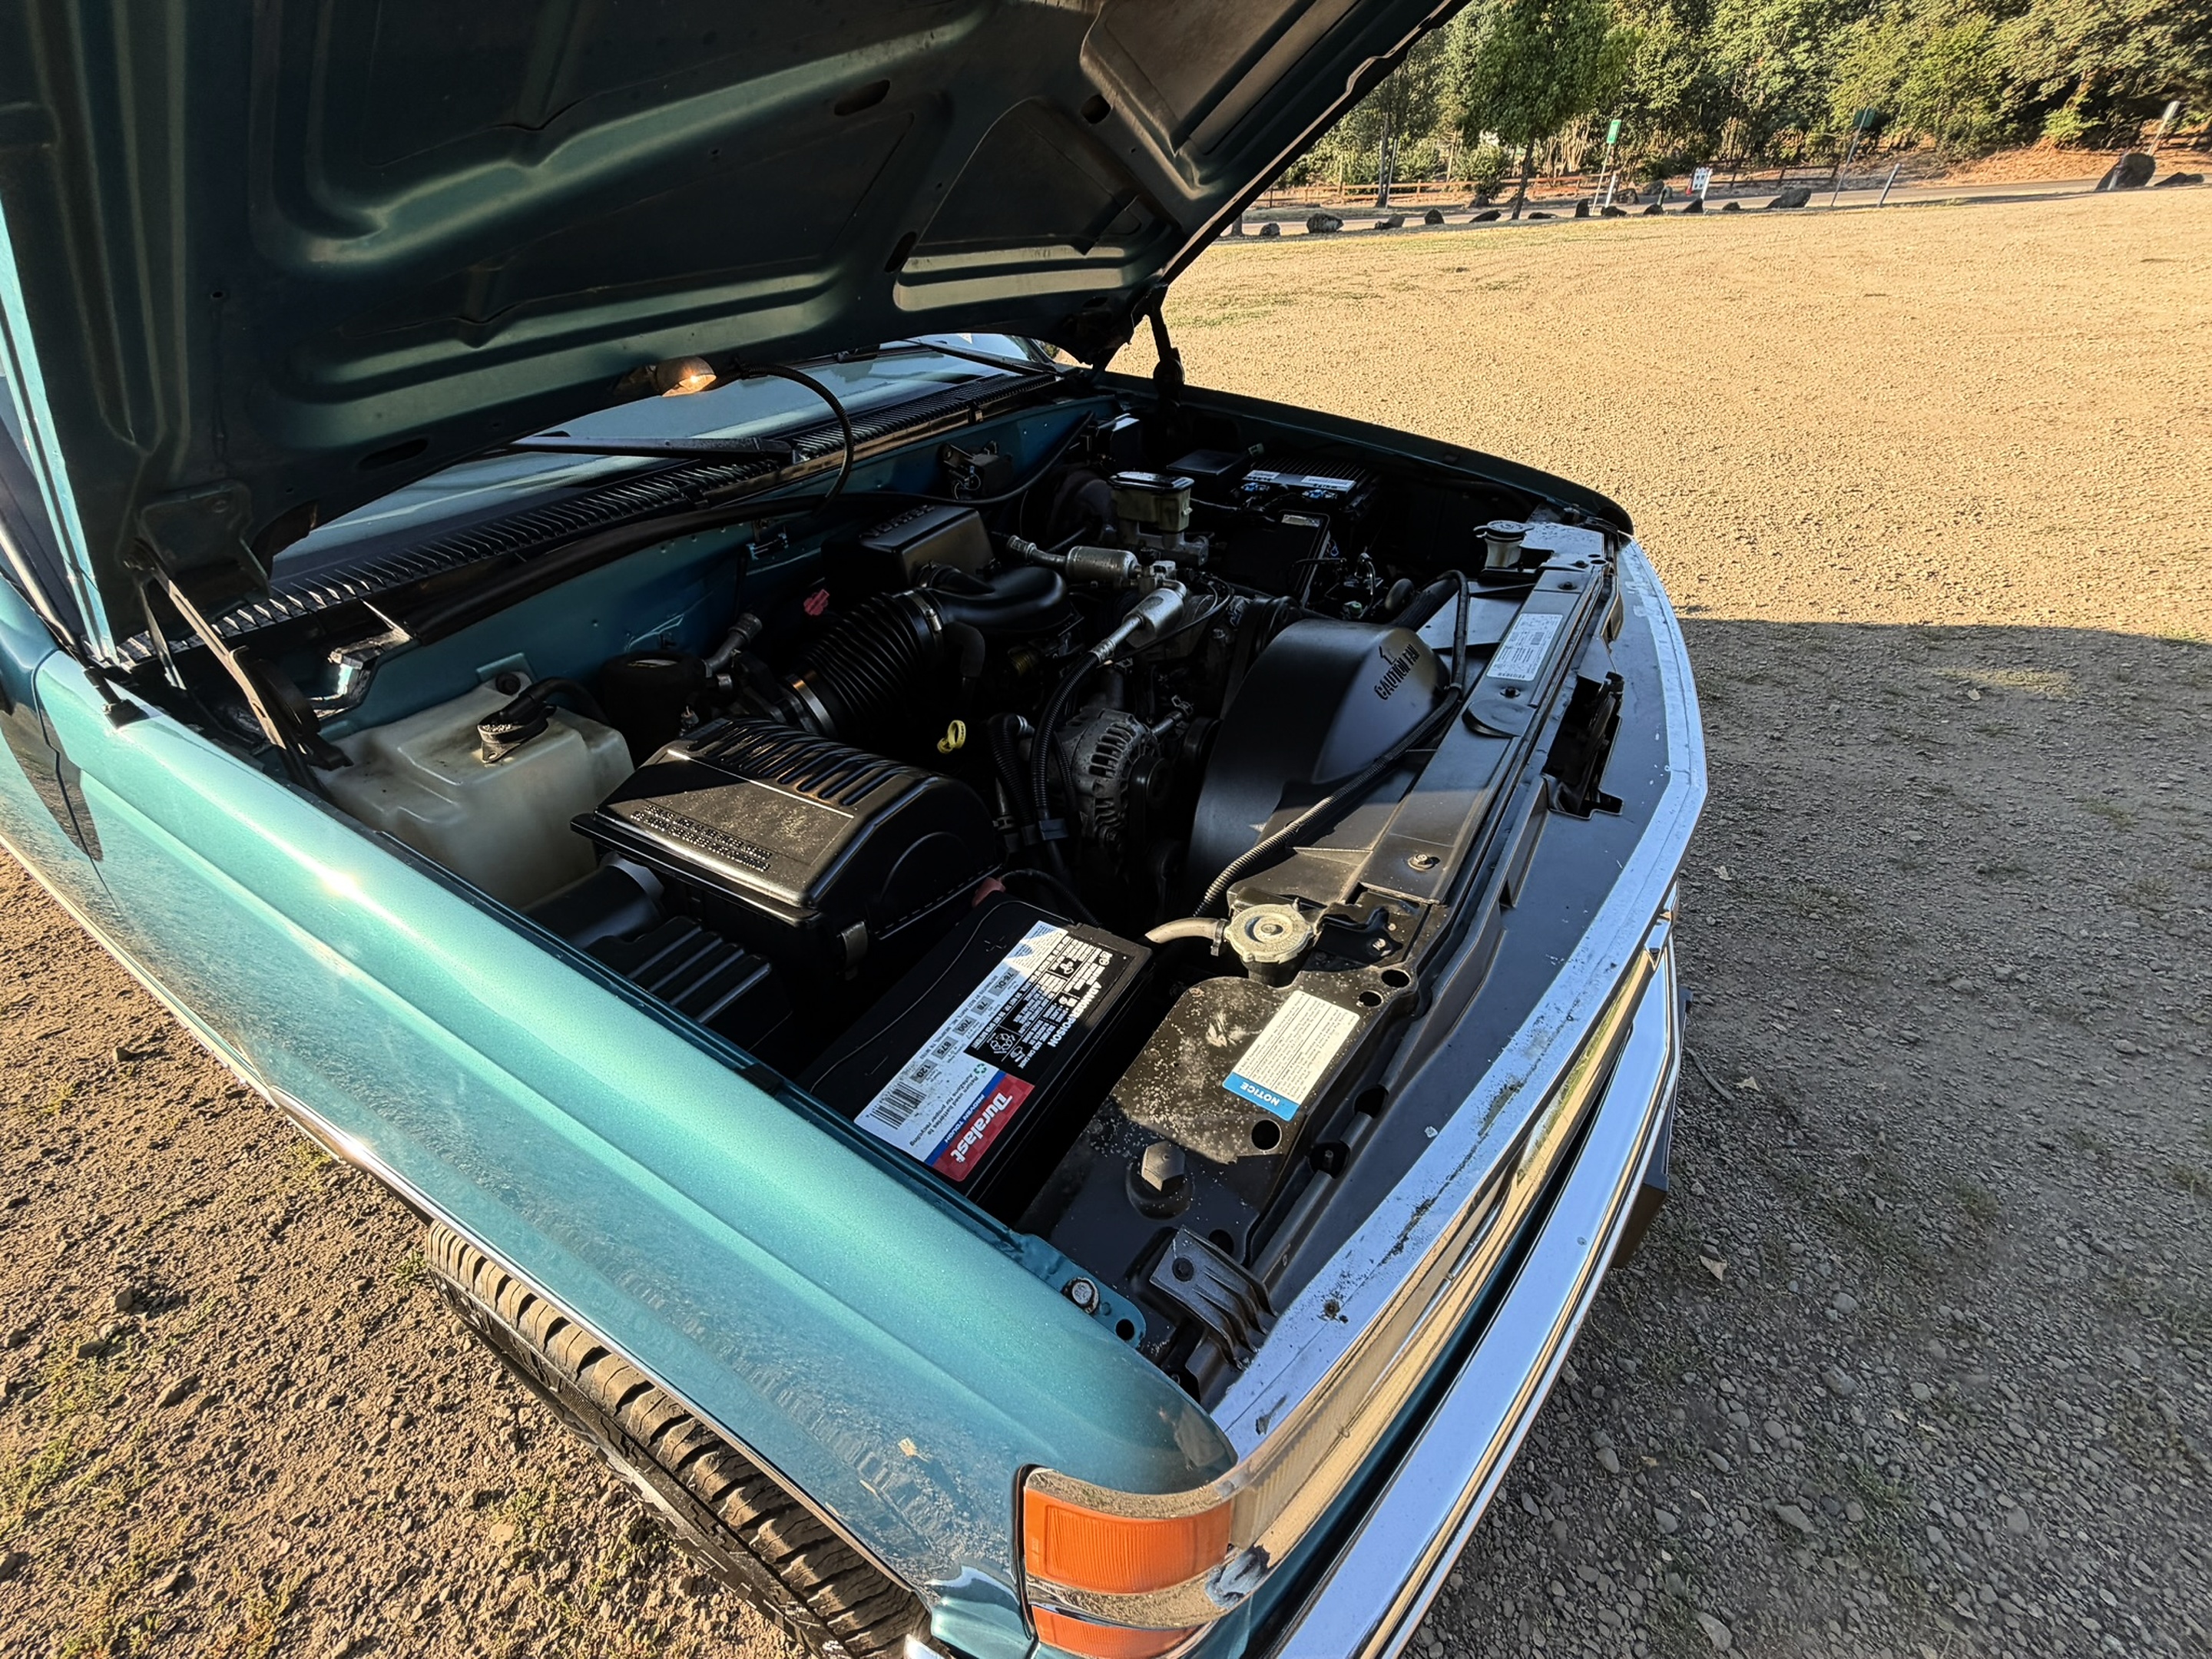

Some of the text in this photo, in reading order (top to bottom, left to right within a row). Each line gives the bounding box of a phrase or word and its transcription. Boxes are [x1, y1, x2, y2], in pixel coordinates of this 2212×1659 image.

[858, 504, 935, 538] VORTEC
[1373, 643, 1420, 699] CAUTION FAN
[975, 1000, 988, 1011] 78
[955, 1018, 972, 1032] 700
[935, 1040, 952, 1055] 875
[914, 1062, 932, 1078] 120
[951, 1072, 974, 1098] AutoZone
[962, 1075, 979, 1093] Return
[1239, 1081, 1281, 1107] NOTICE
[951, 1091, 965, 1106] used
[929, 1103, 947, 1123] proper
[931, 1104, 955, 1129] batteries
[942, 1093, 985, 1144] PROVEN TOUGH
[907, 1121, 932, 1147] recycling
[949, 1091, 1013, 1163] Duralast
